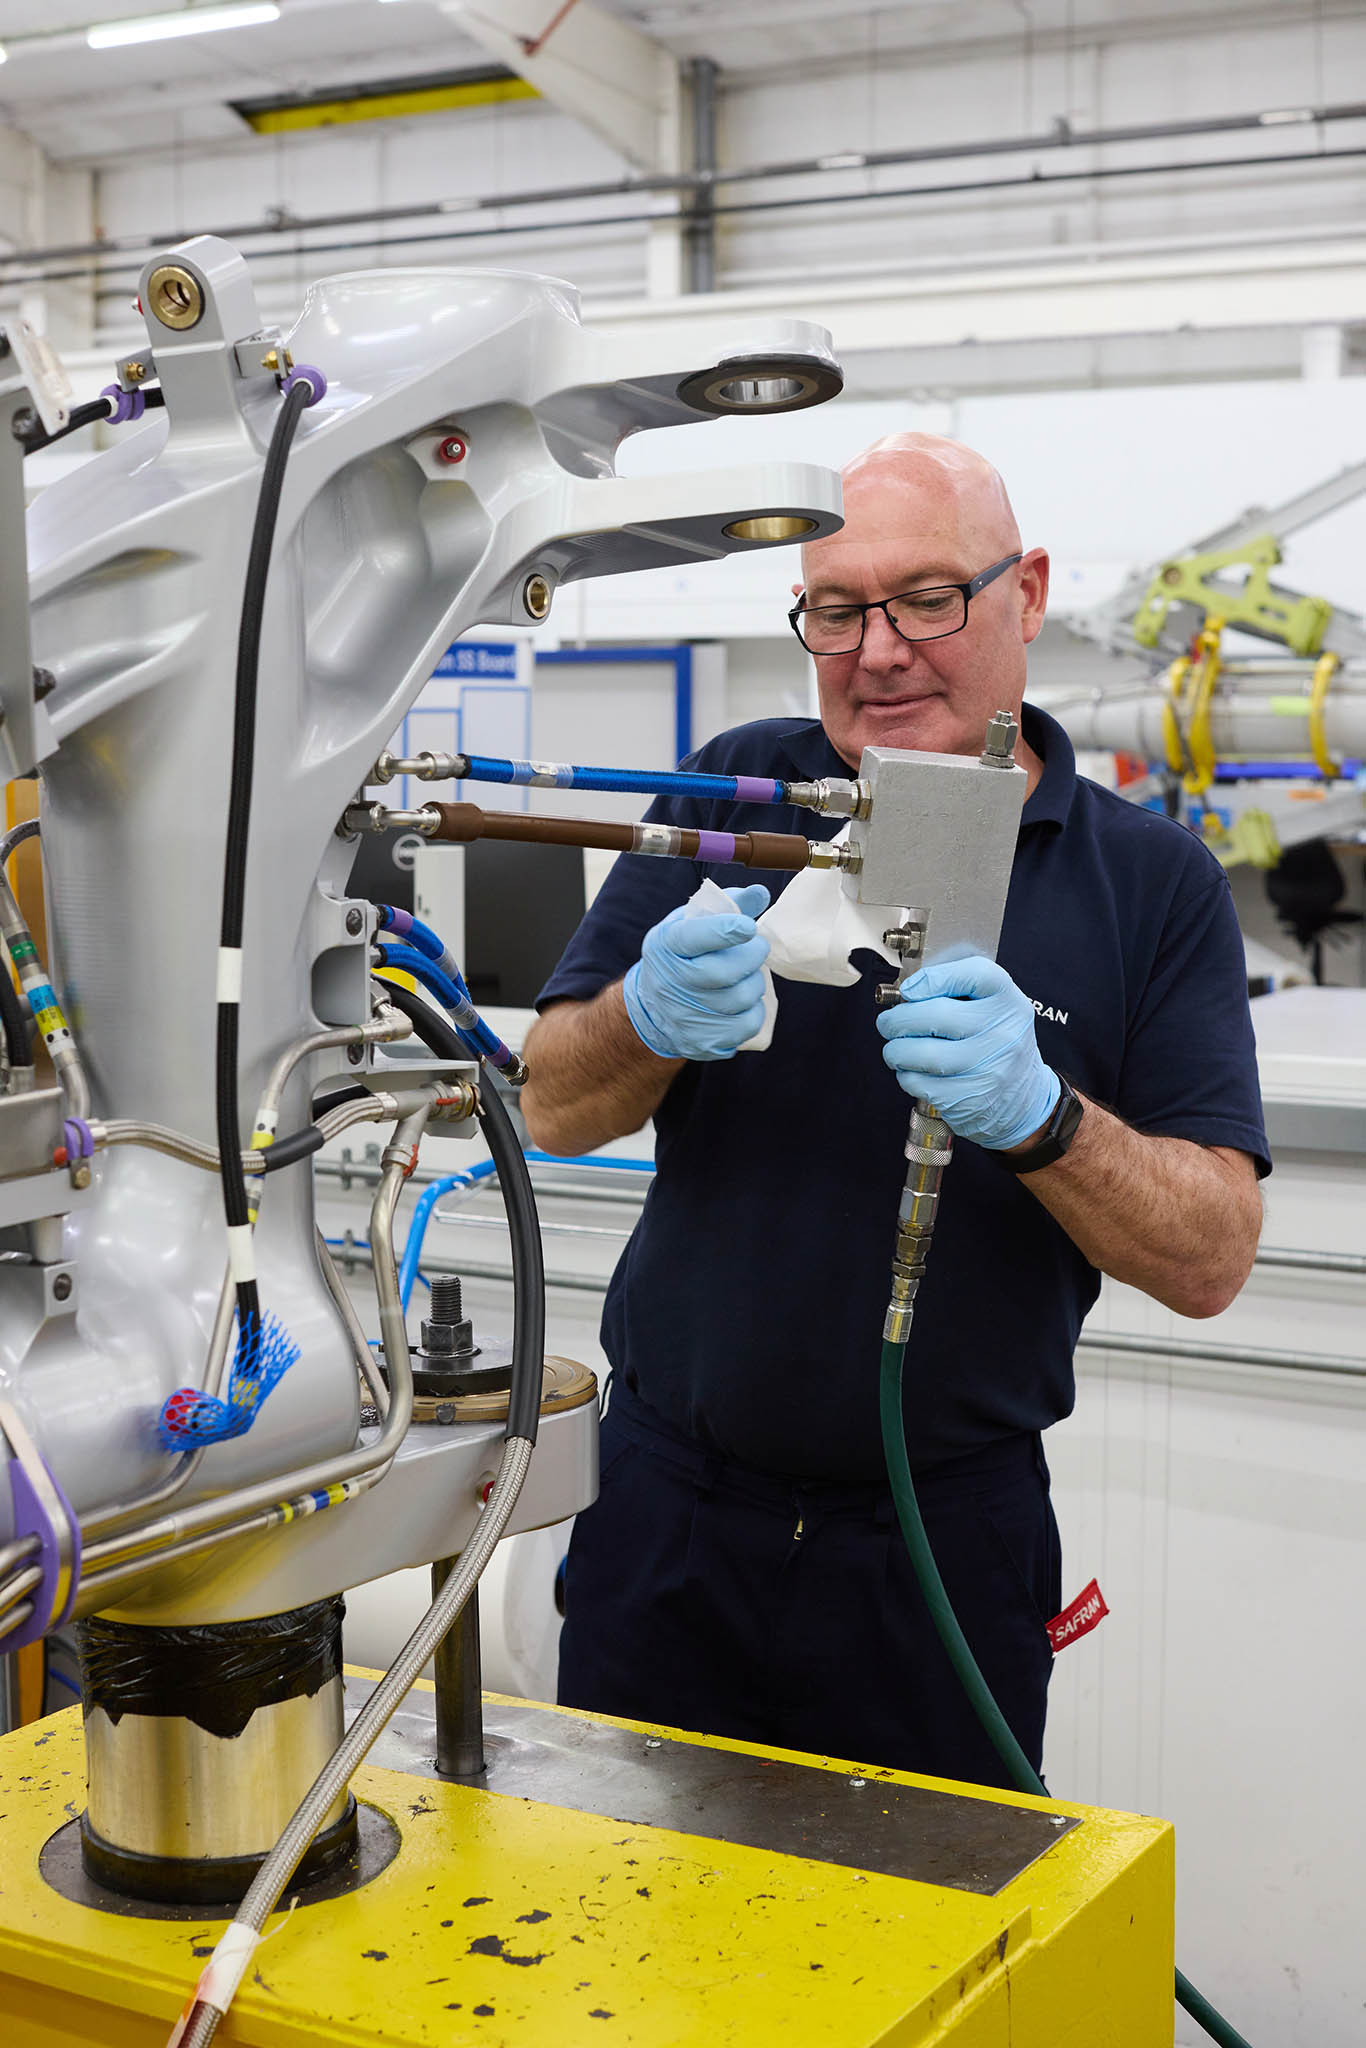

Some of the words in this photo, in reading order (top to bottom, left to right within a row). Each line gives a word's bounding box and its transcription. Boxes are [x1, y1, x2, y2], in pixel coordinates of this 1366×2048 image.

[477, 649, 516, 672] Board
[1029, 998, 1069, 1025] RAN
[1055, 1594, 1101, 1642] SAFRAN
